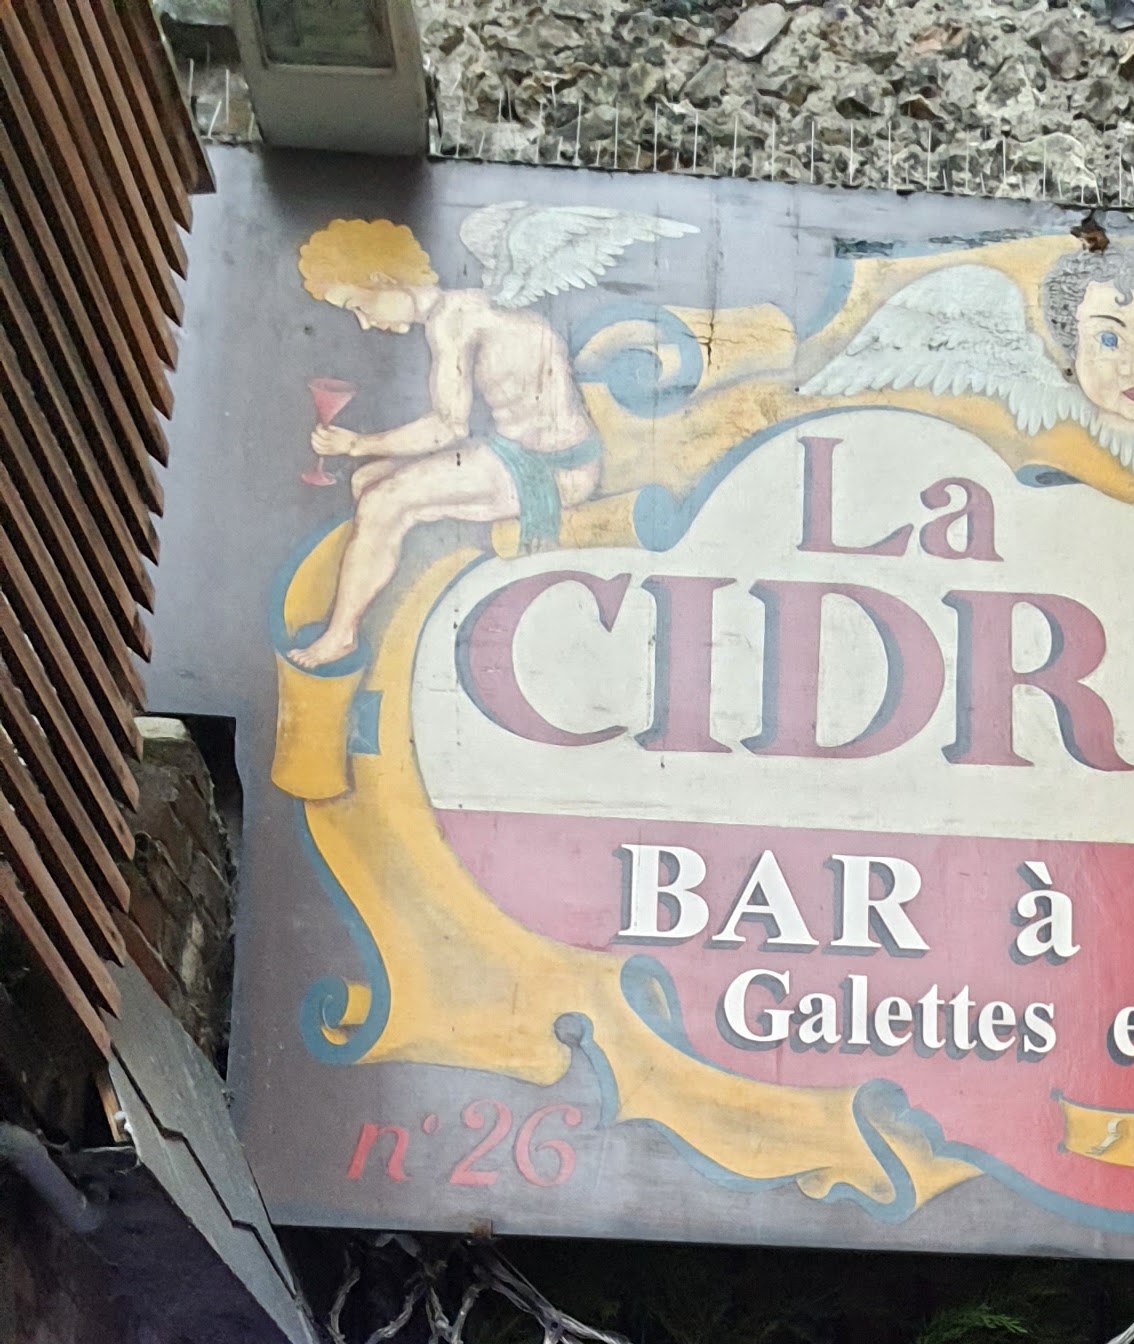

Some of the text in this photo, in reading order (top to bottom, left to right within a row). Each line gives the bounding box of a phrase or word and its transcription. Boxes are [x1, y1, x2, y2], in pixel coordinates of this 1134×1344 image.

[796, 435, 1004, 562] La
[615, 843, 931, 956] BAR
[1012, 861, 1082, 963] à
[720, 967, 1059, 1060] Galettes
